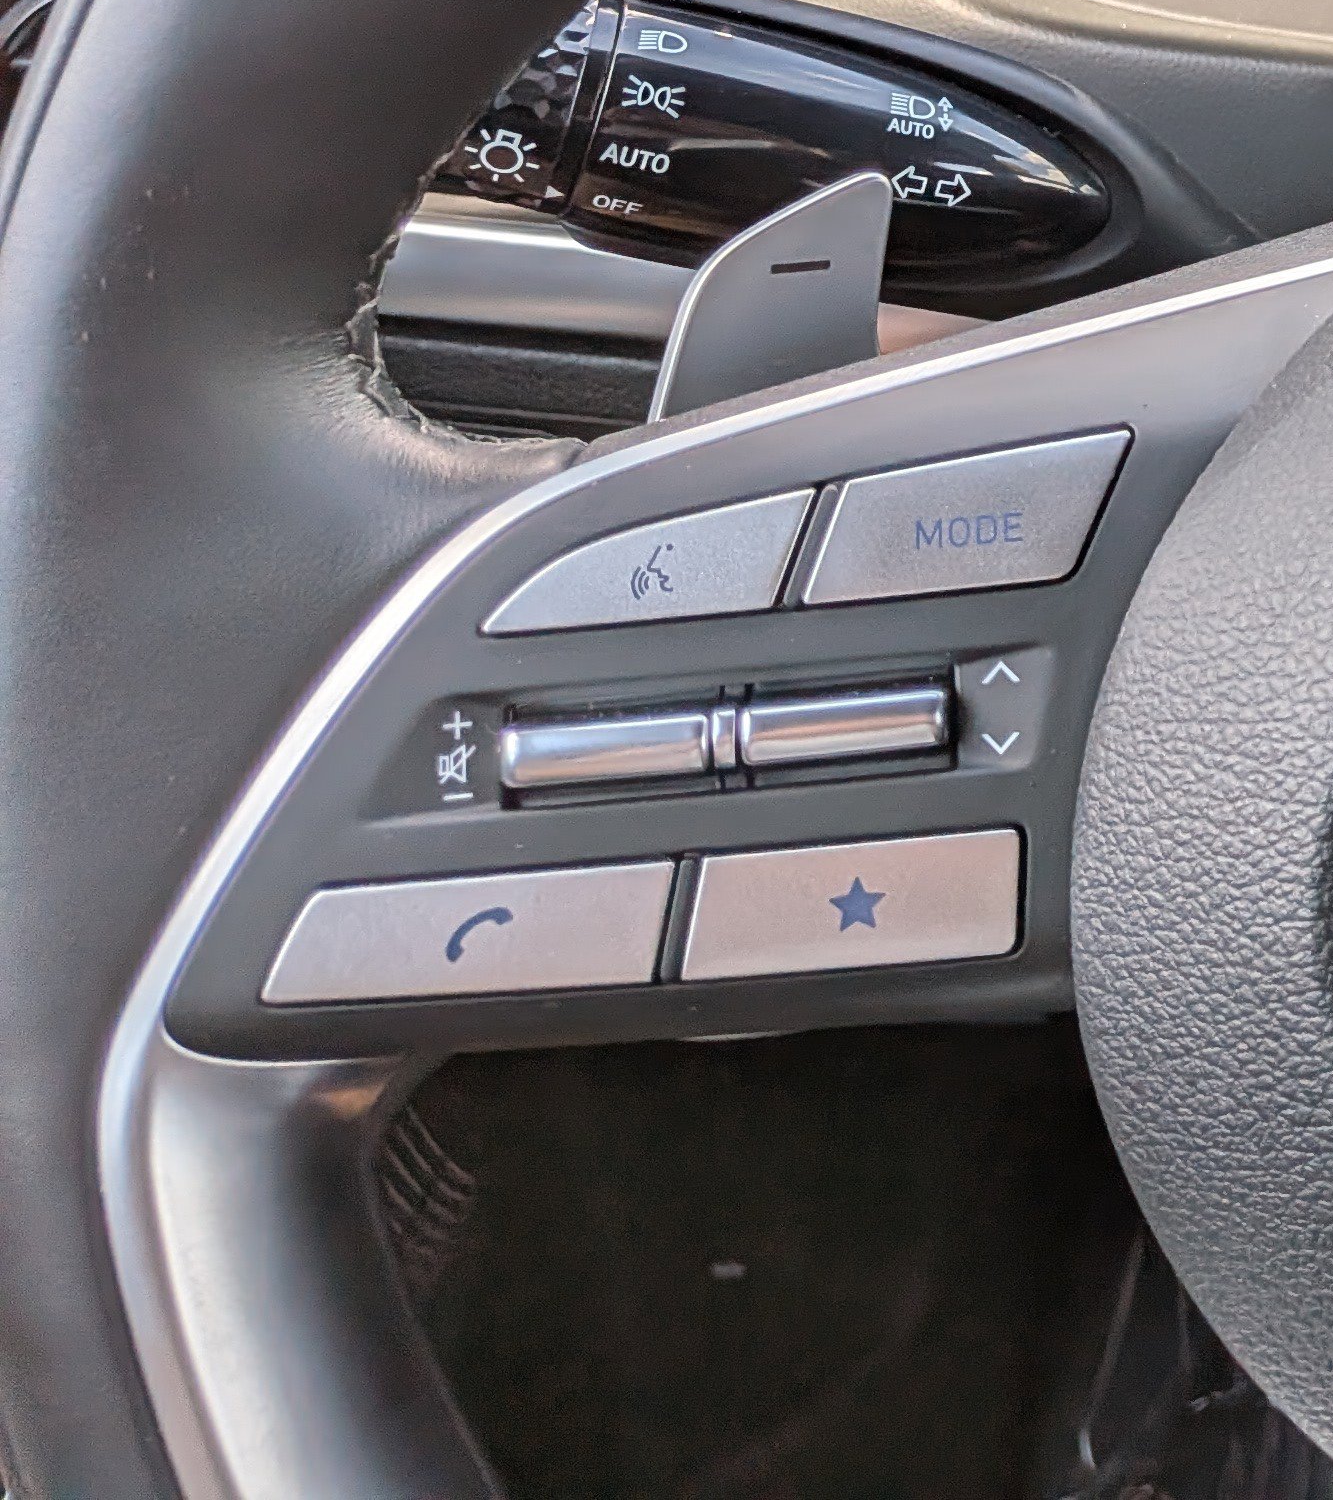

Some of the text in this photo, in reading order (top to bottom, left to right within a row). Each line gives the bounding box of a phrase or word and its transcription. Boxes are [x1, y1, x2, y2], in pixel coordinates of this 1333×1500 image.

[886, 116, 935, 140] AUTO
[600, 141, 670, 174] AUTO
[592, 194, 643, 217] OFF
[914, 511, 1025, 551] MODE
